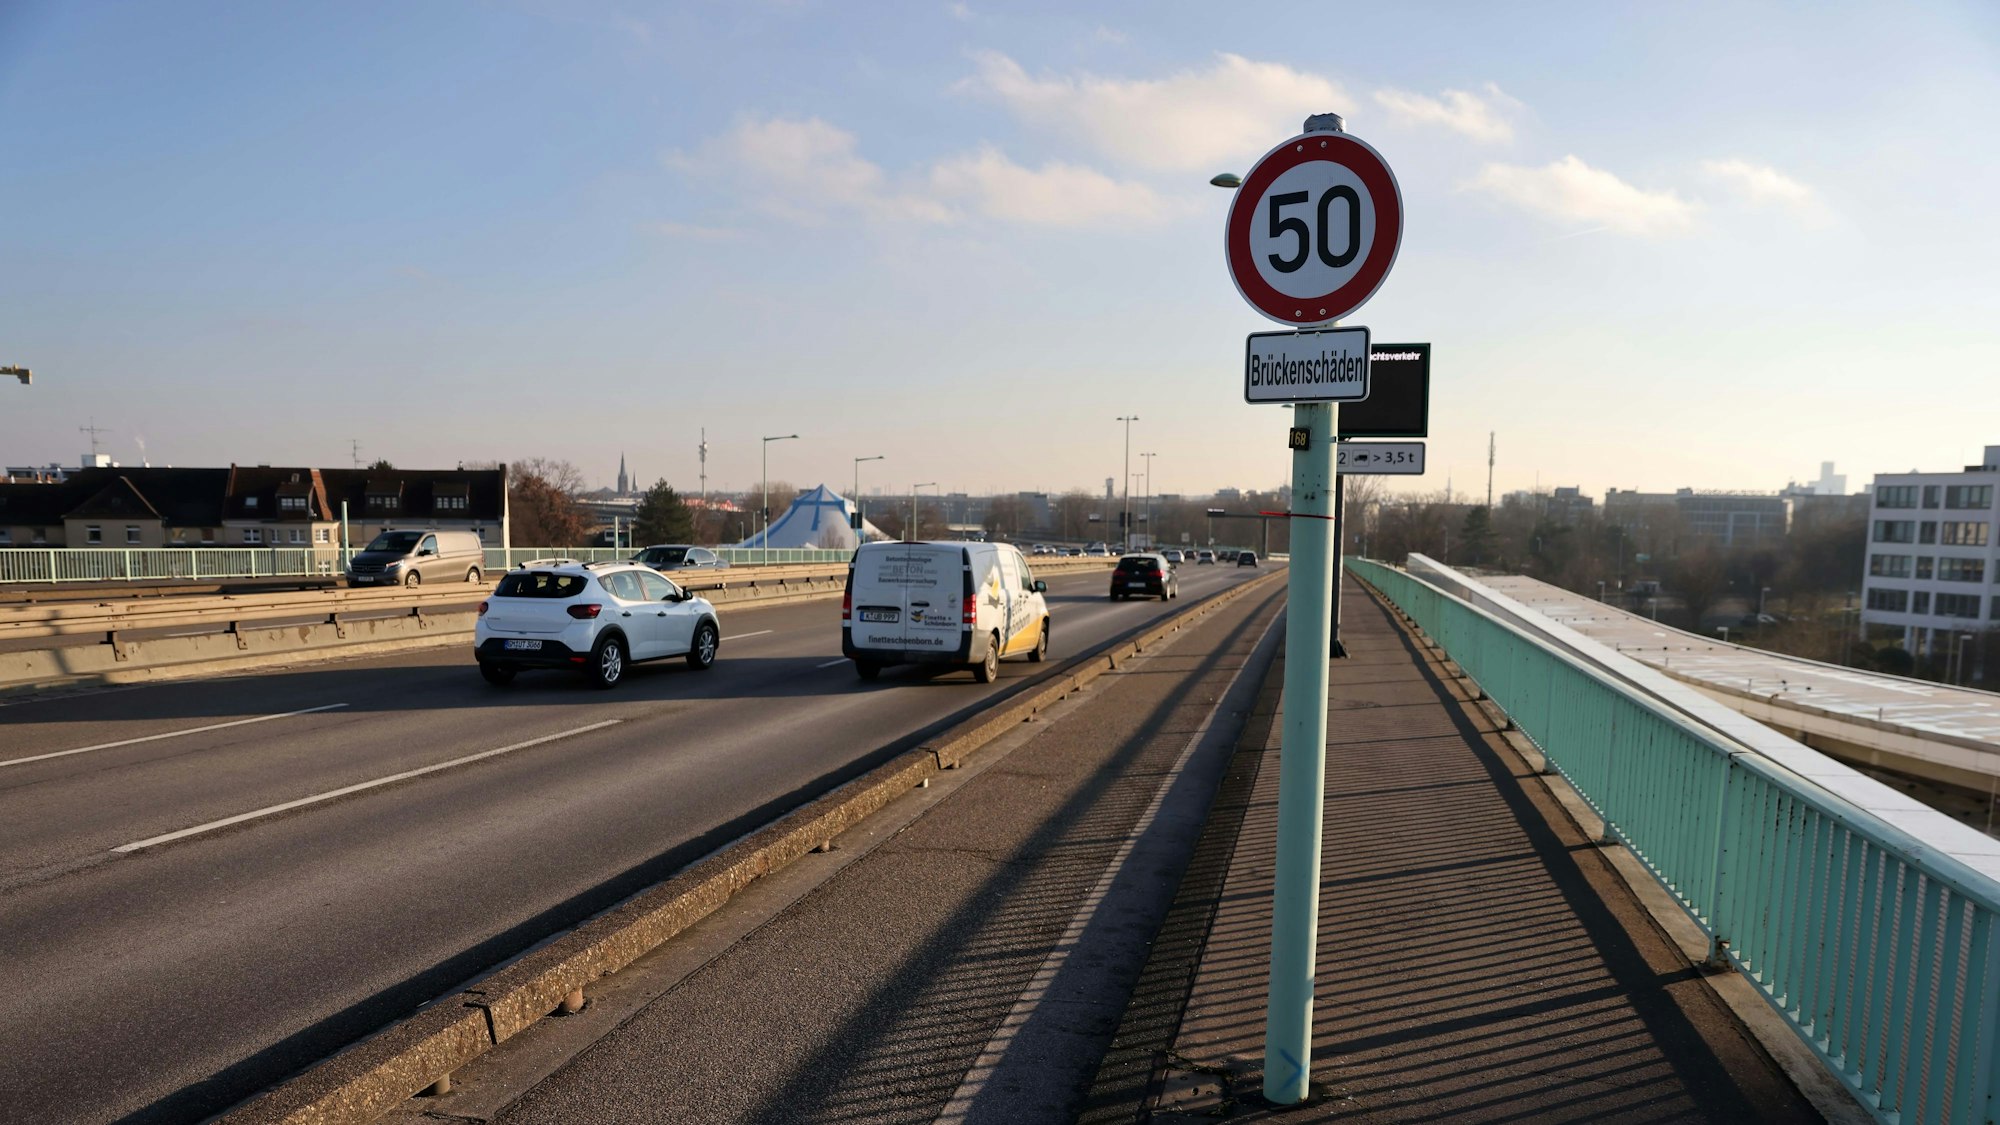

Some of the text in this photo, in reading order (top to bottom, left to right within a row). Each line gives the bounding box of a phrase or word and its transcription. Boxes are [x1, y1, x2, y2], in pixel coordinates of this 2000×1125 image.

[1268, 184, 1361, 273] 50
[1251, 349, 1363, 386] Brückenschäden
[1289, 431, 1307, 446] 168
[1338, 452, 1346, 464] 2
[1385, 451, 1405, 464] 3,5
[1408, 453, 1414, 463] t
[893, 565, 923, 574] BETON
[868, 636, 943, 646] finetteschoenborn.de
